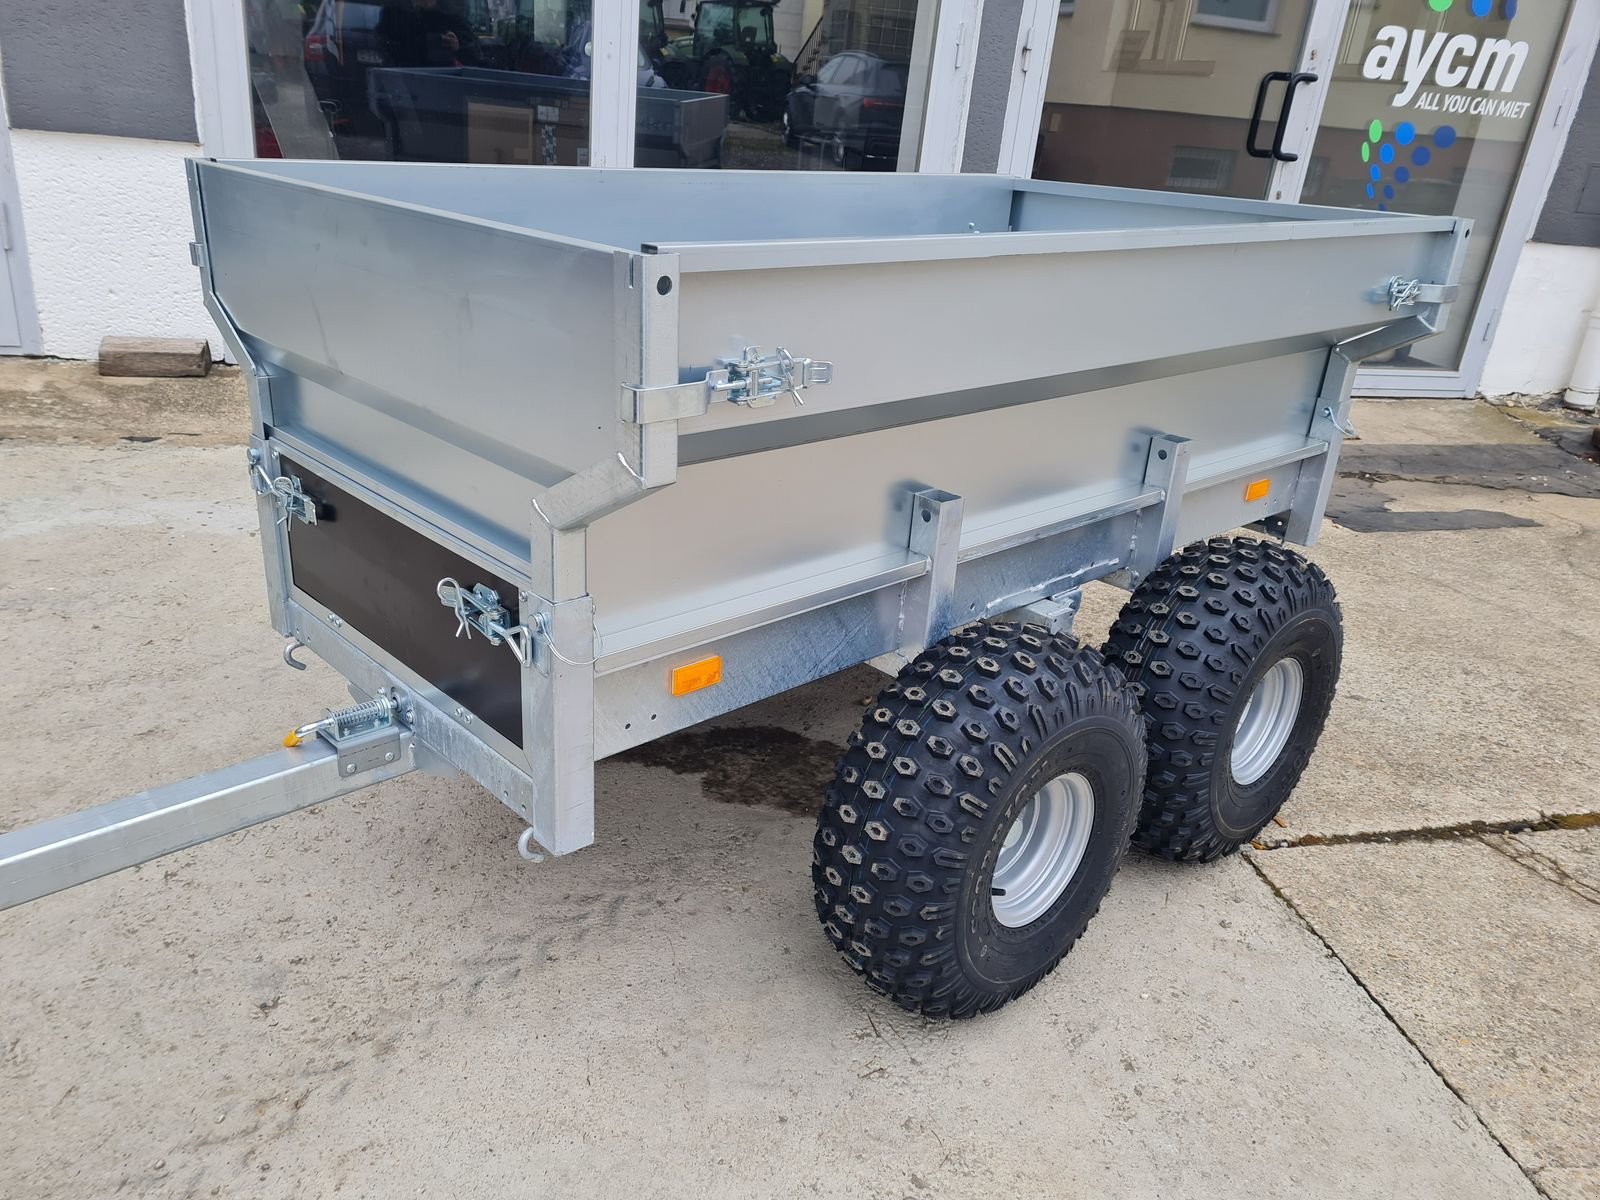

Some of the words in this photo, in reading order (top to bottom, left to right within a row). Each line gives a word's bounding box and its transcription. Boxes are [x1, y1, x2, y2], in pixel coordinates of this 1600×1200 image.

[1363, 25, 1529, 107] aycm
[1414, 92, 1440, 111] ALL
[1442, 94, 1471, 113] YOU
[1471, 97, 1497, 115] CAN
[1496, 101, 1531, 119] MIET
